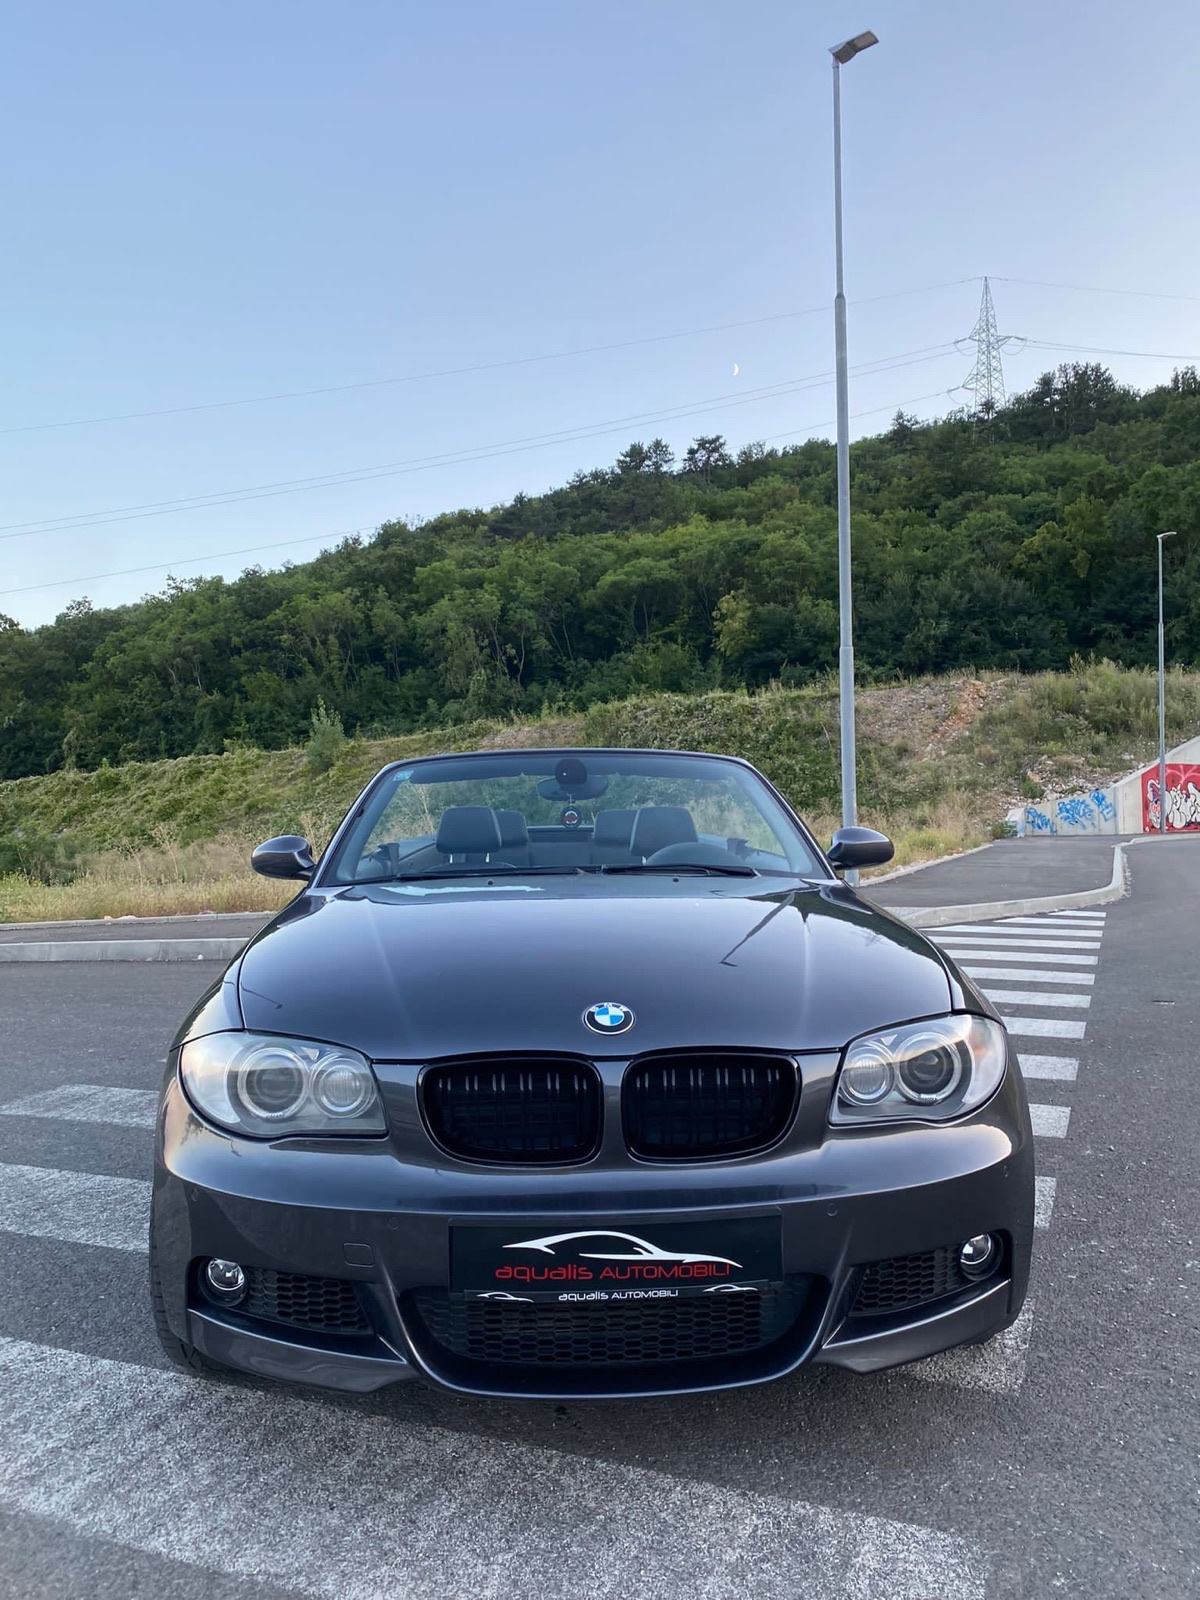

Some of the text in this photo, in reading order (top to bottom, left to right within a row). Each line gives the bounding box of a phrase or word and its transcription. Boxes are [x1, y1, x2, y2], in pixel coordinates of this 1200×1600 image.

[495, 1263, 729, 1282] aqualis AUTOMOBILI
[558, 1289, 678, 1302] aqualis AUTOMOBILI
